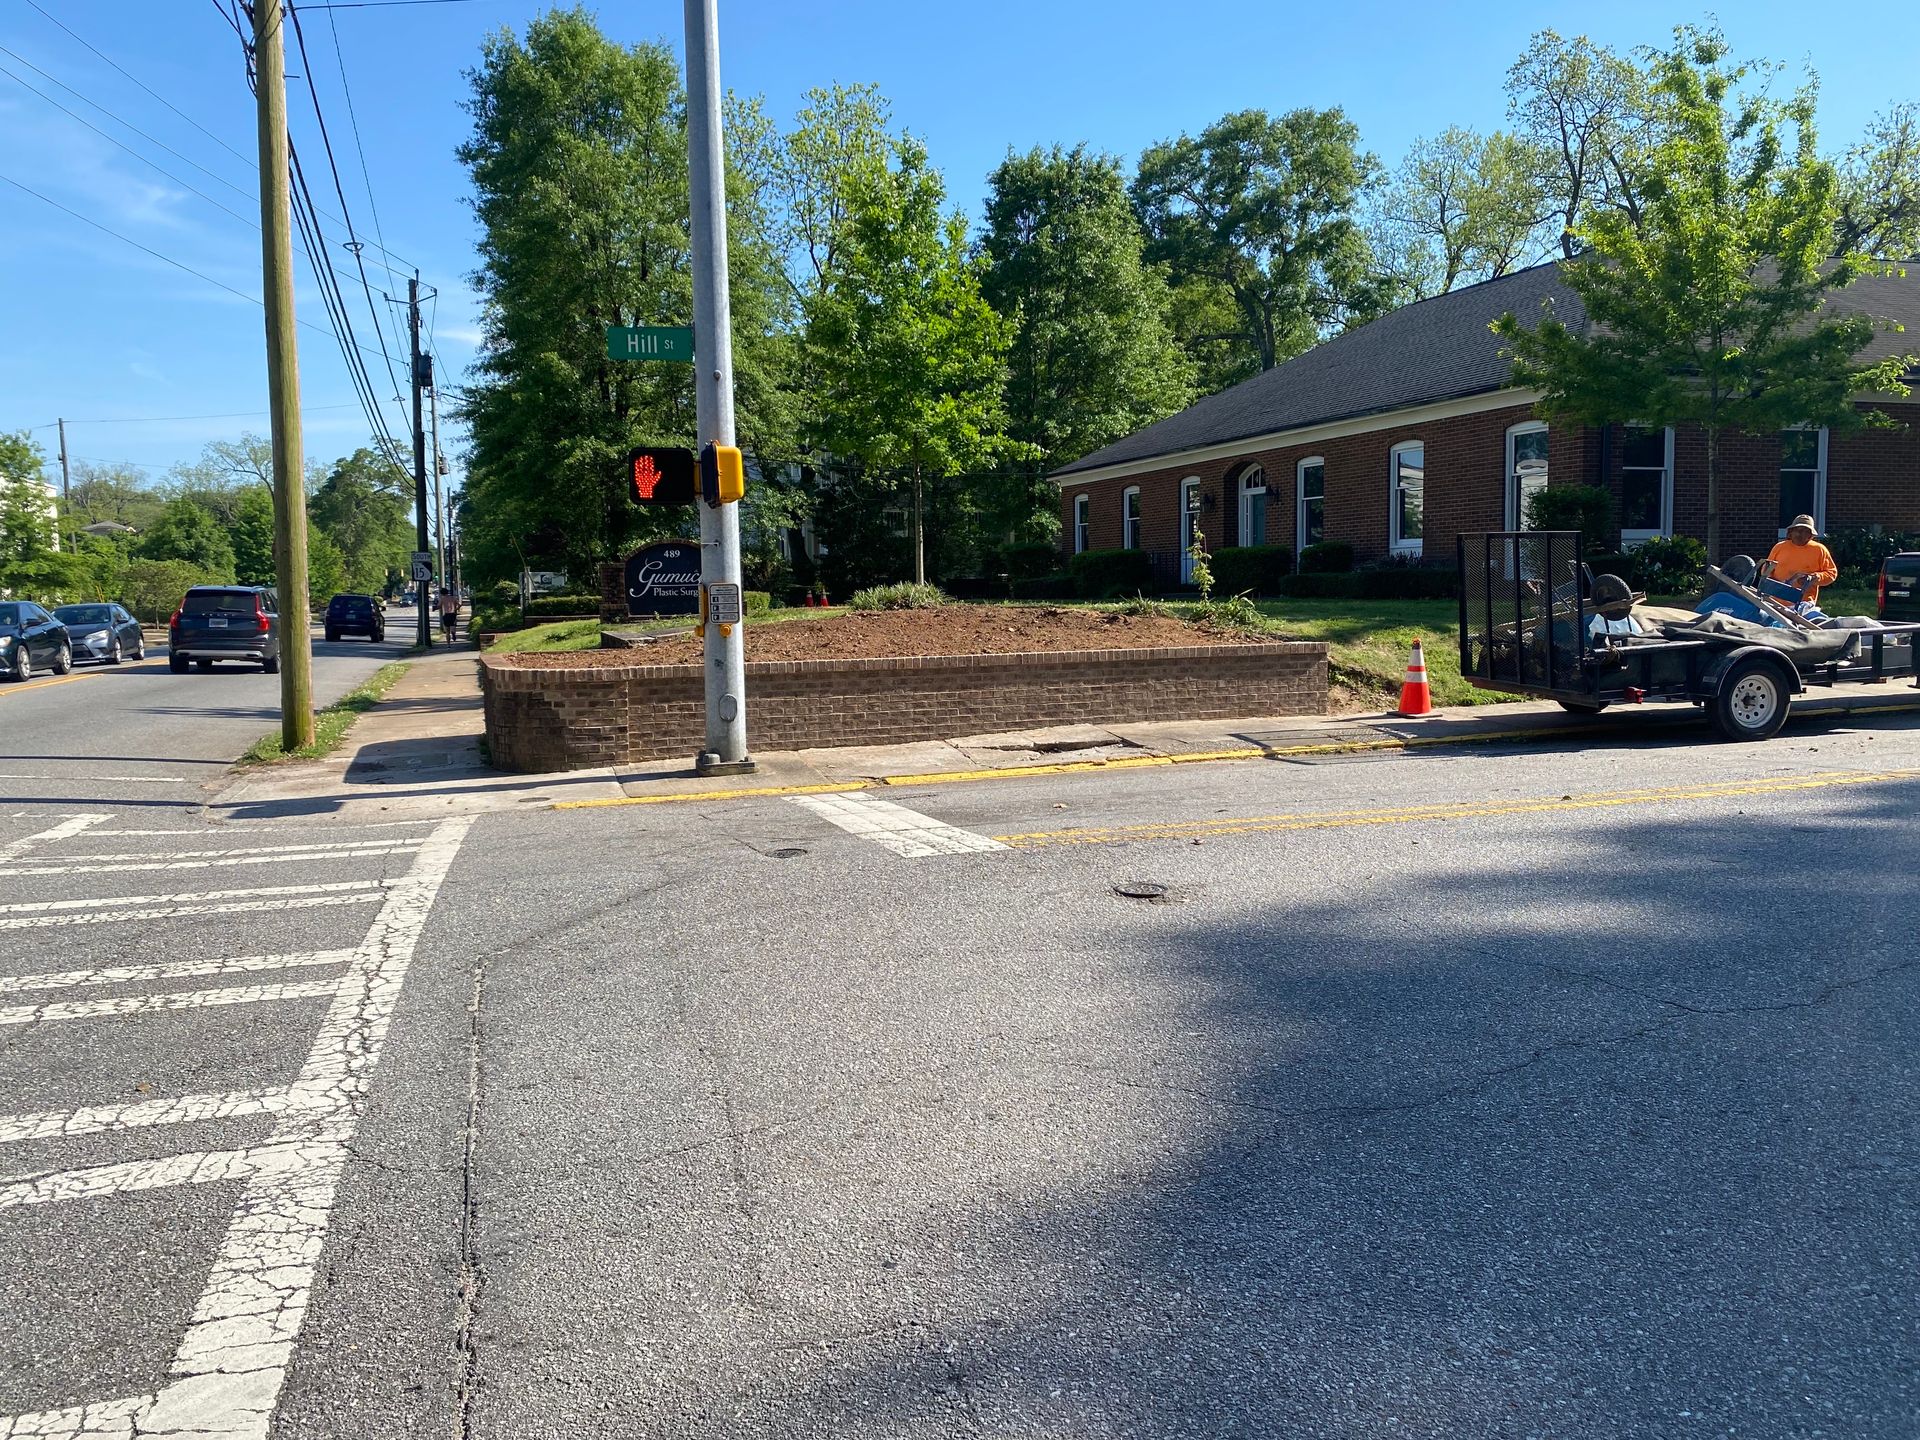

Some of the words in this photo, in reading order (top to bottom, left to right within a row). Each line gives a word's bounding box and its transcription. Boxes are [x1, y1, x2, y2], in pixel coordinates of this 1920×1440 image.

[627, 334, 658, 353] Hill
[664, 339, 674, 350] St
[663, 549, 681, 559] 489
[415, 567, 425, 579] 15
[629, 558, 702, 598] Gumuc
[653, 587, 679, 597] Plastic
[680, 587, 699, 598] Surg
